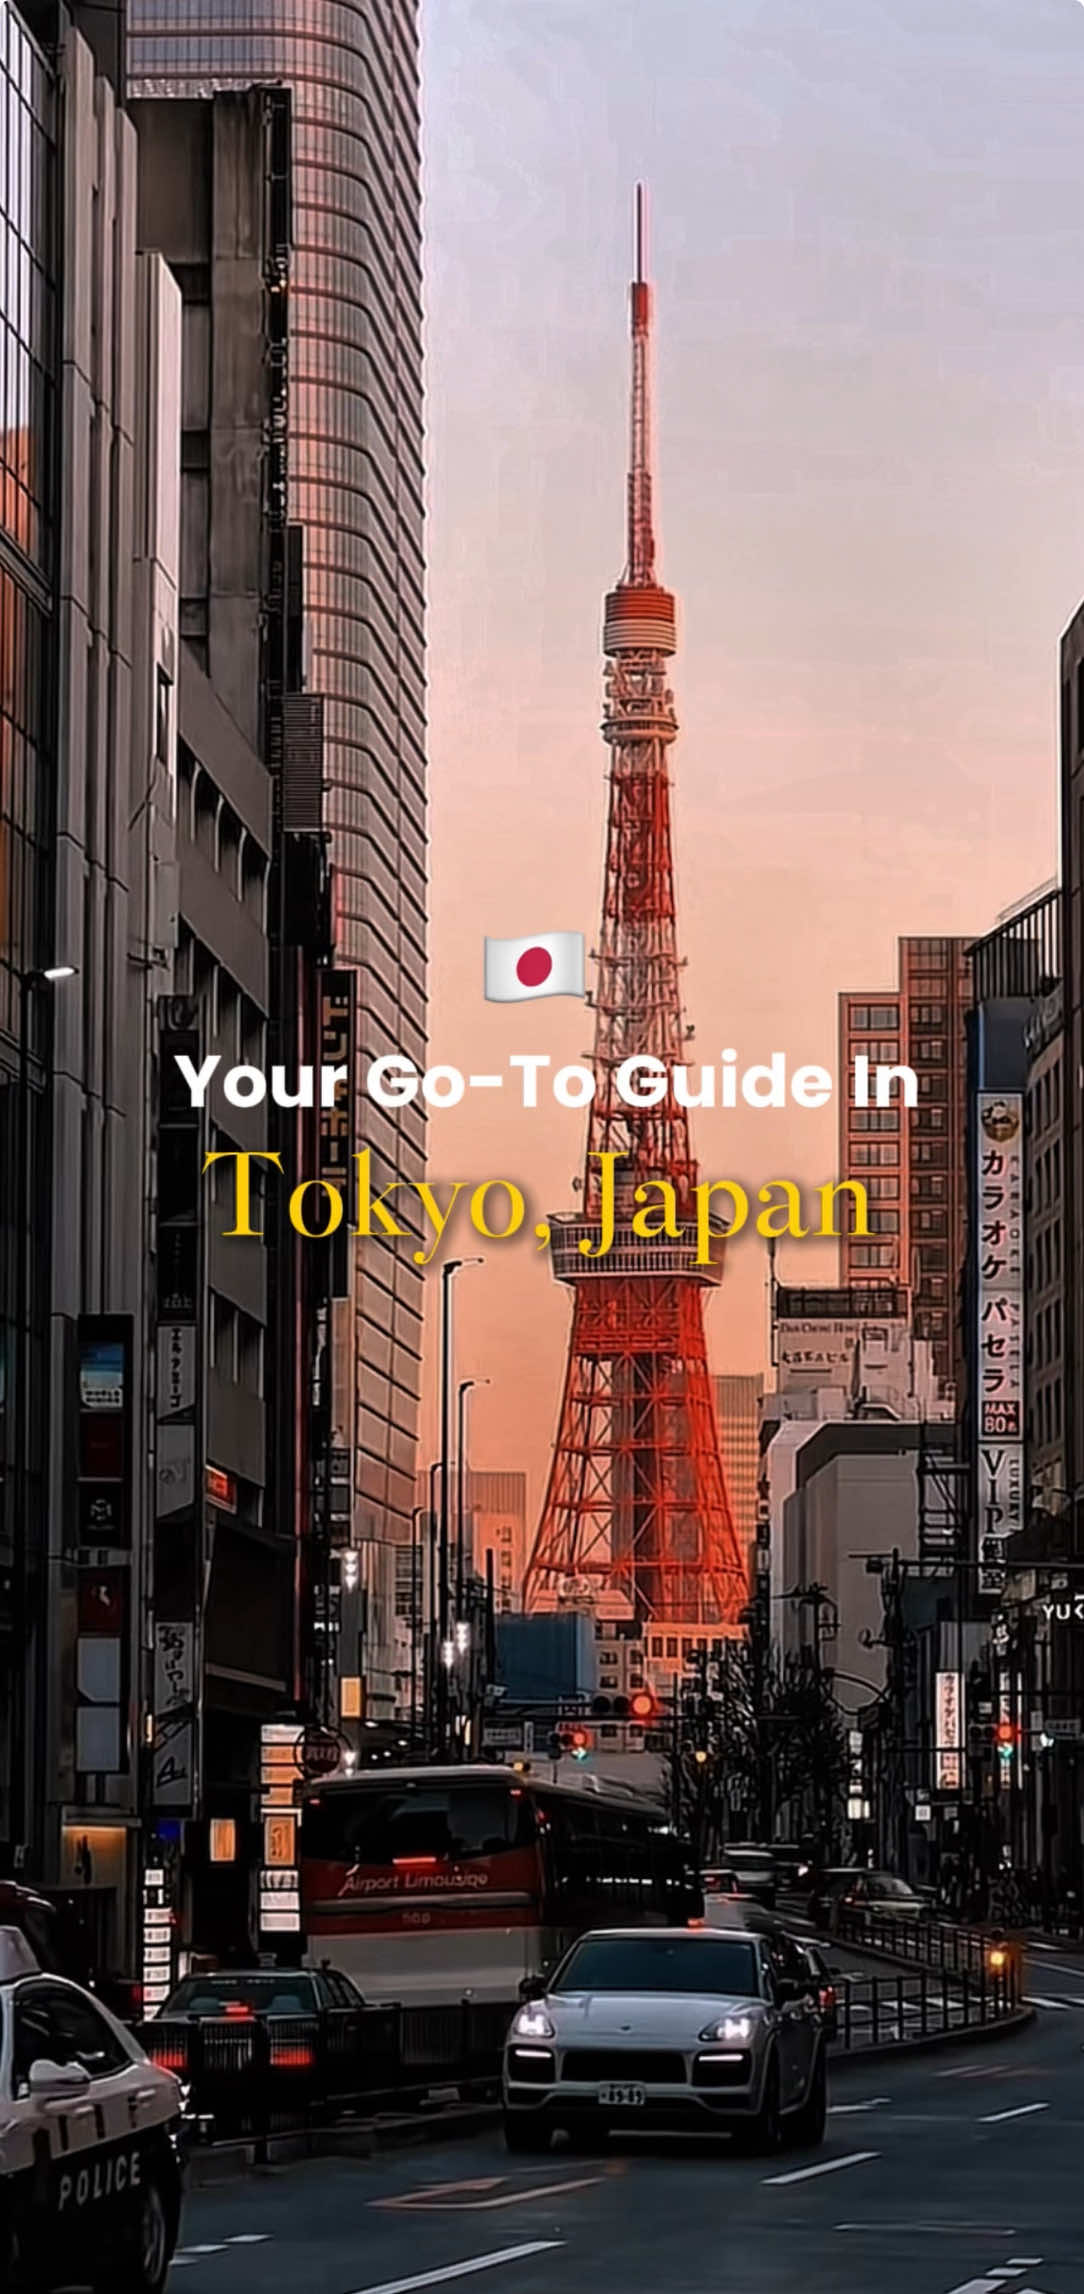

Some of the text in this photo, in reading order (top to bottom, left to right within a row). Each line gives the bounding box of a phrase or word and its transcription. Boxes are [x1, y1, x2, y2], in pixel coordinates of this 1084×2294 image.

[981, 1149, 1008, 1394] カラオケ パセラ
[984, 1402, 1016, 1416] MAX
[1008, 1459, 1020, 1522] LUXURY
[338, 1871, 399, 1896] Airport
[57, 2150, 141, 2211] POLICE
